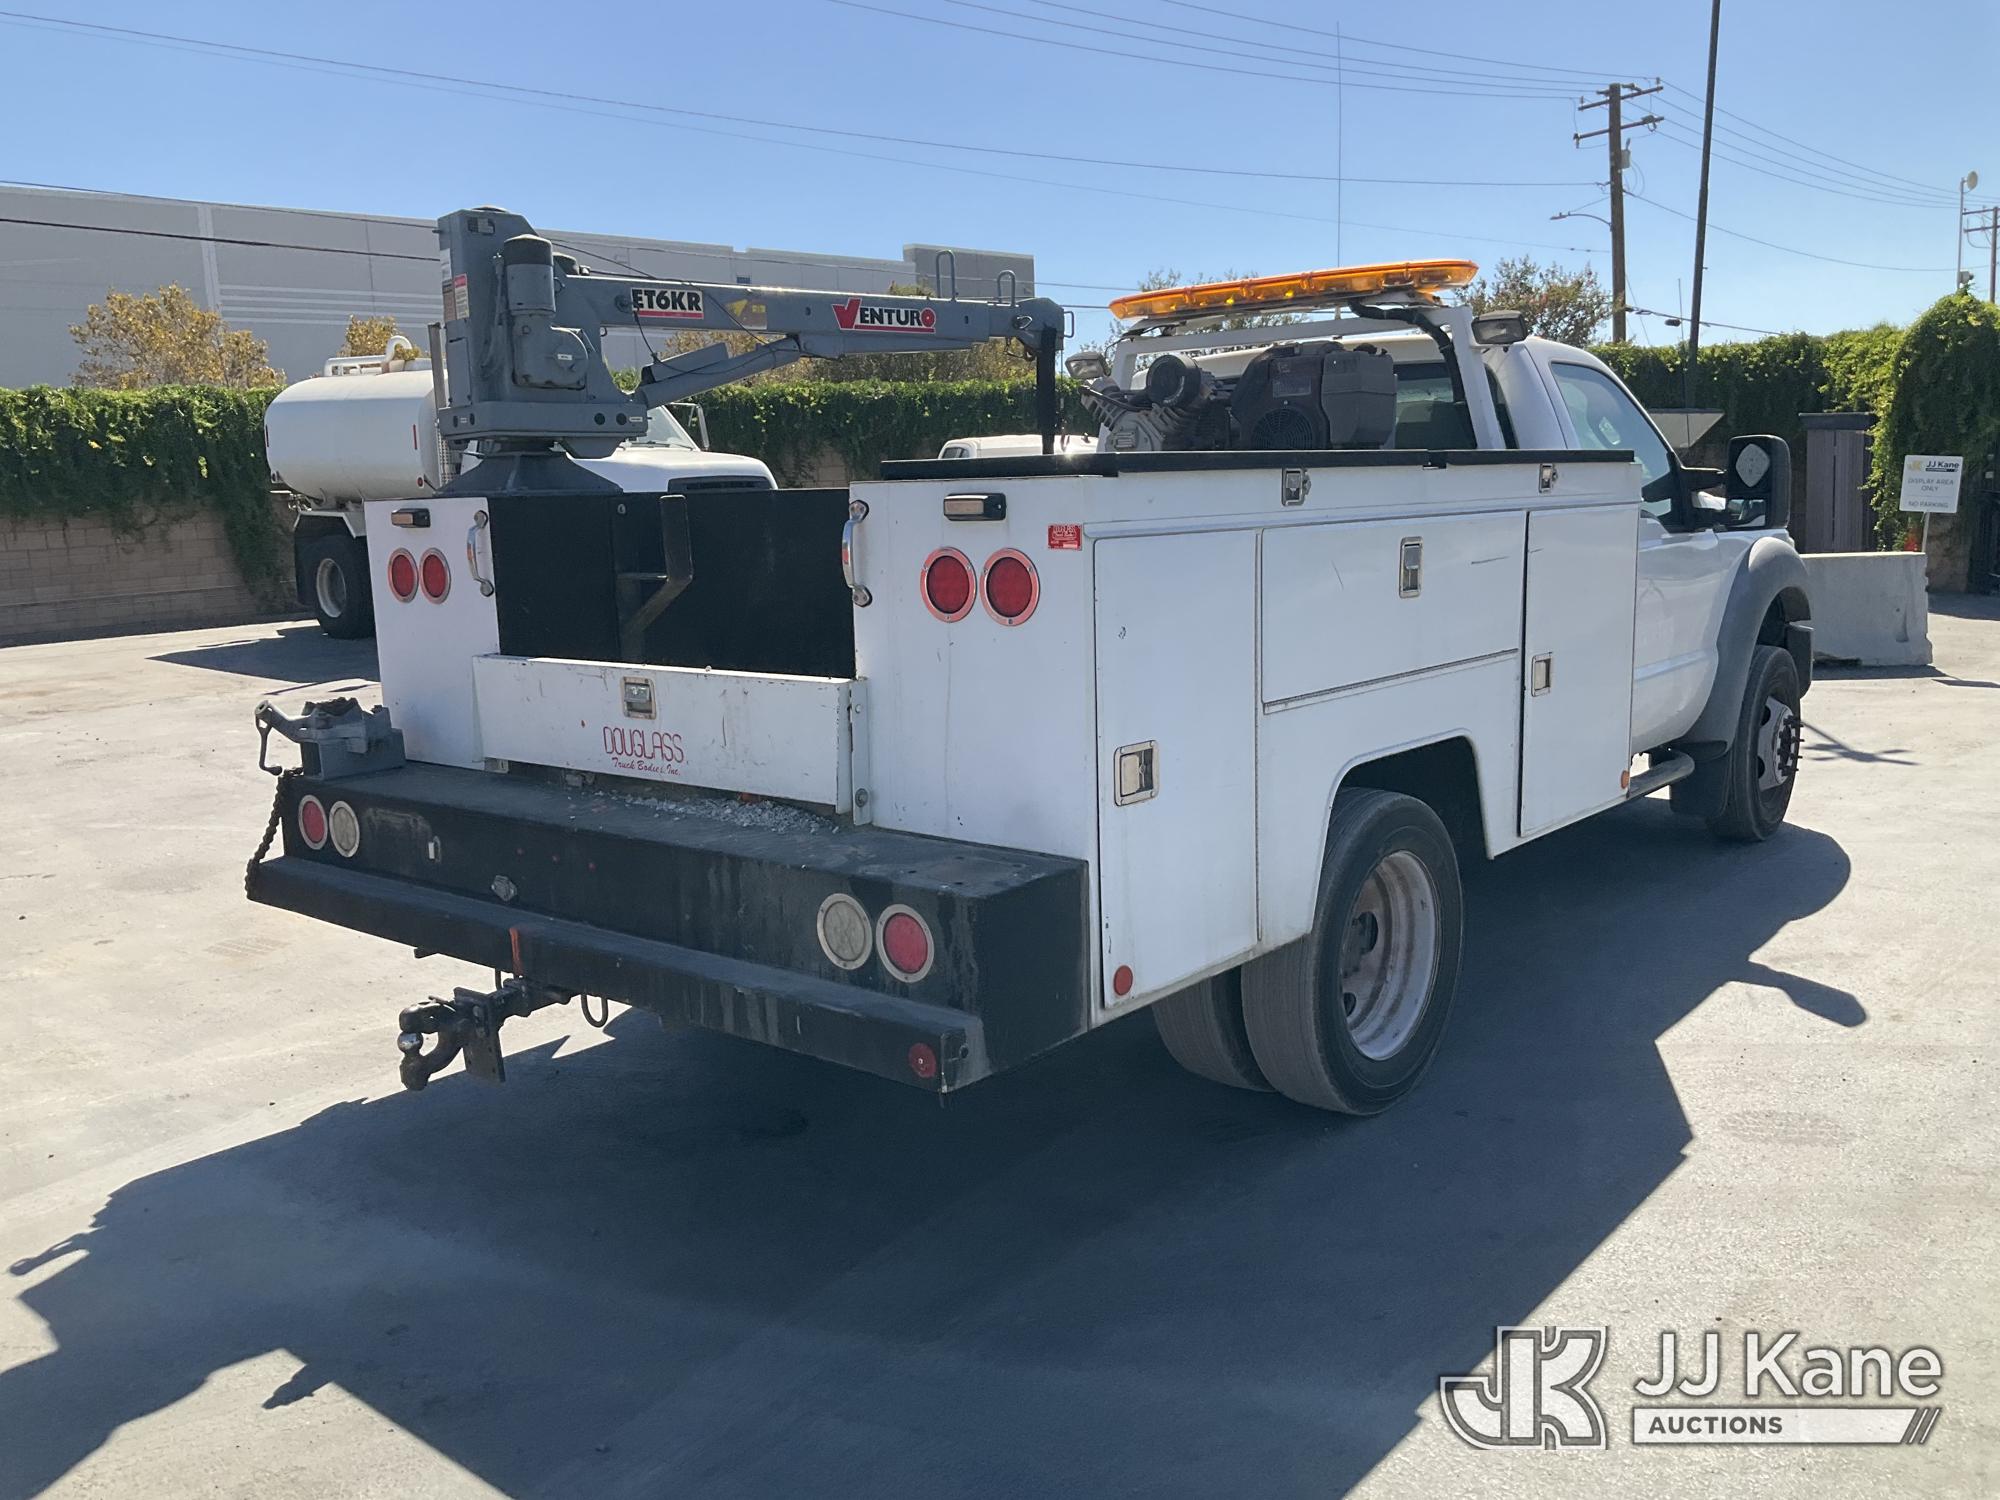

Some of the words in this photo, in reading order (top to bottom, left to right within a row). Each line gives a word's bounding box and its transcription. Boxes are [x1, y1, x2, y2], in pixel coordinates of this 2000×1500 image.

[631, 288, 702, 311] ET6KR
[832, 298, 936, 329] VENTURO
[1938, 461, 1960, 469] Kane
[603, 726, 684, 763] DOUGLASS
[612, 757, 635, 770] Truck
[666, 764, 681, 776] Inc.
